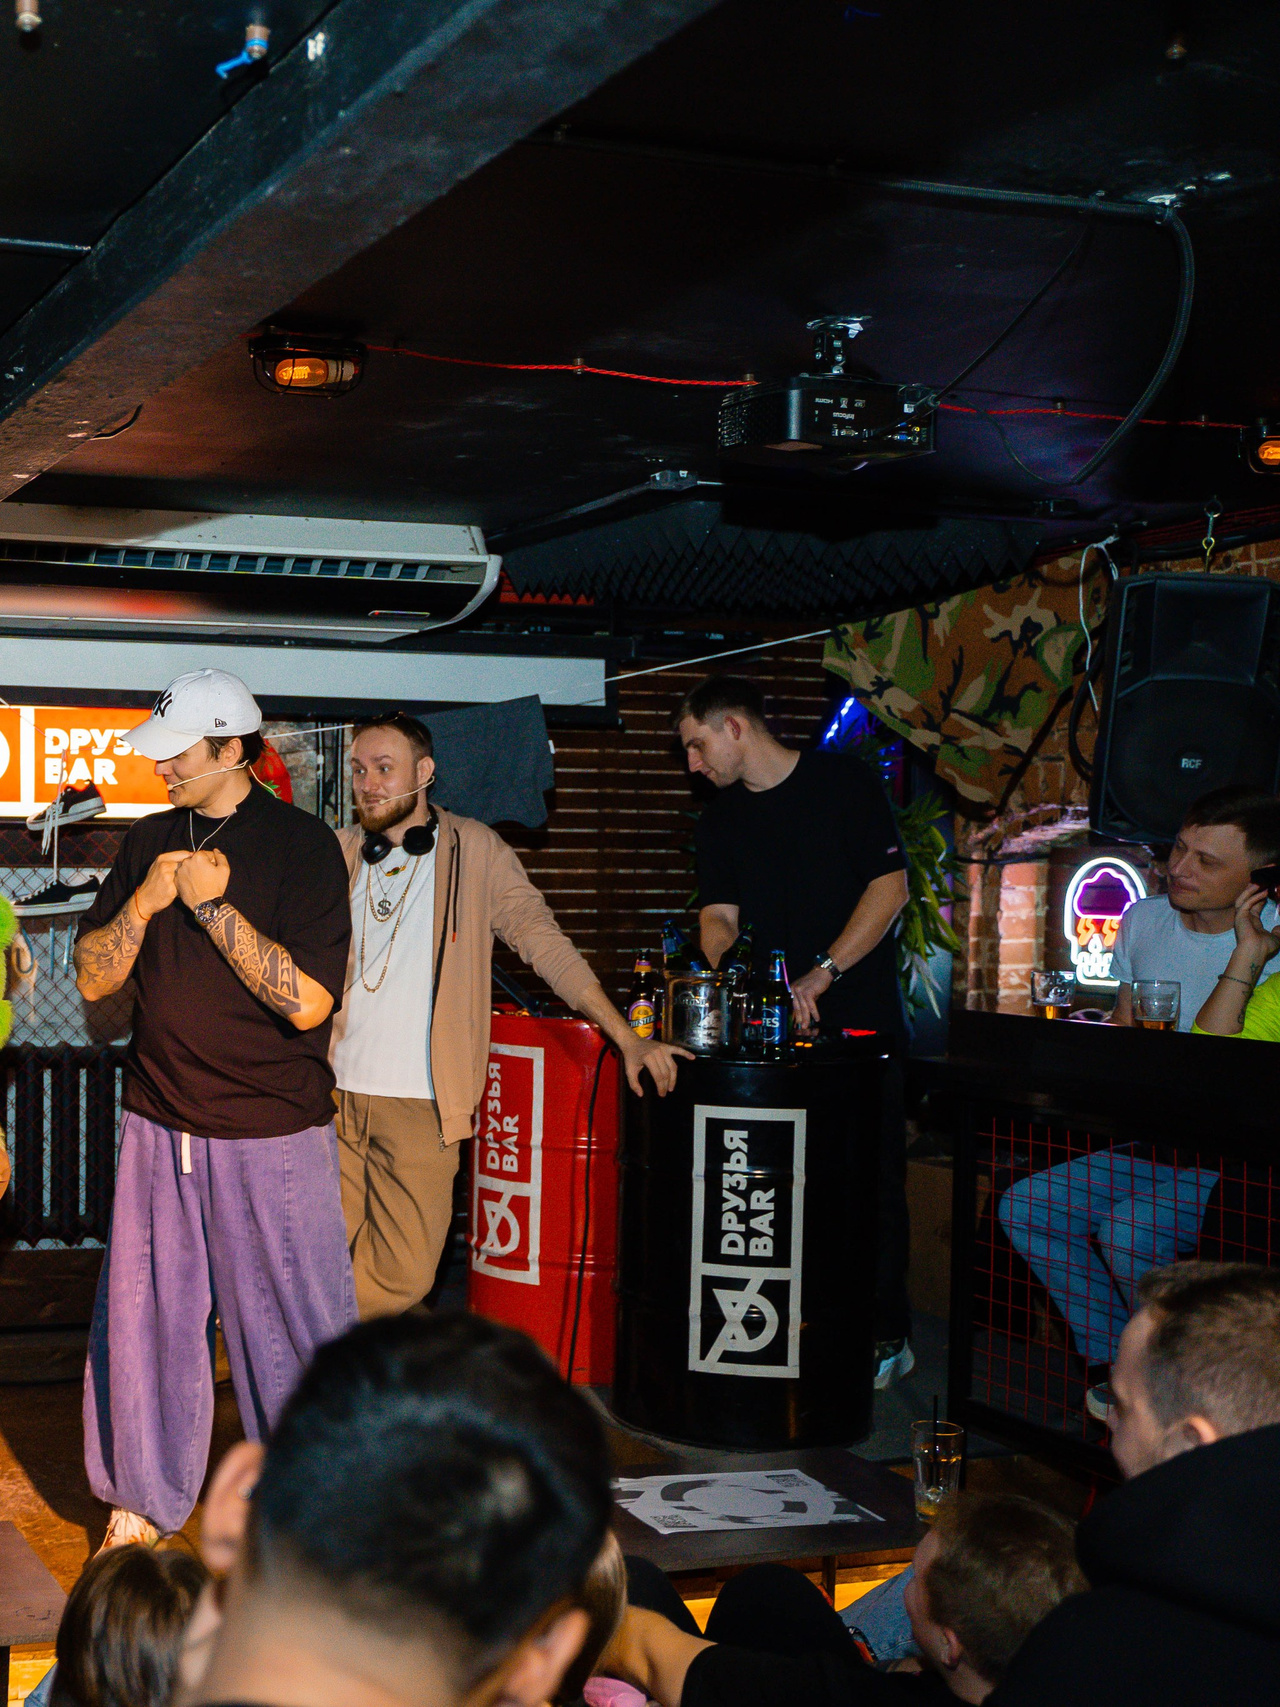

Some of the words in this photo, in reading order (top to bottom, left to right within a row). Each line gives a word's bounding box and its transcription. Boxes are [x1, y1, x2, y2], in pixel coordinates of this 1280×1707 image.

[45, 728, 142, 756] DРУЗ
[45, 758, 118, 785] BAR
[1181, 757, 1203, 769] RCF
[501, 1114, 519, 1173] BAR
[748, 1187, 775, 1257] BAR
